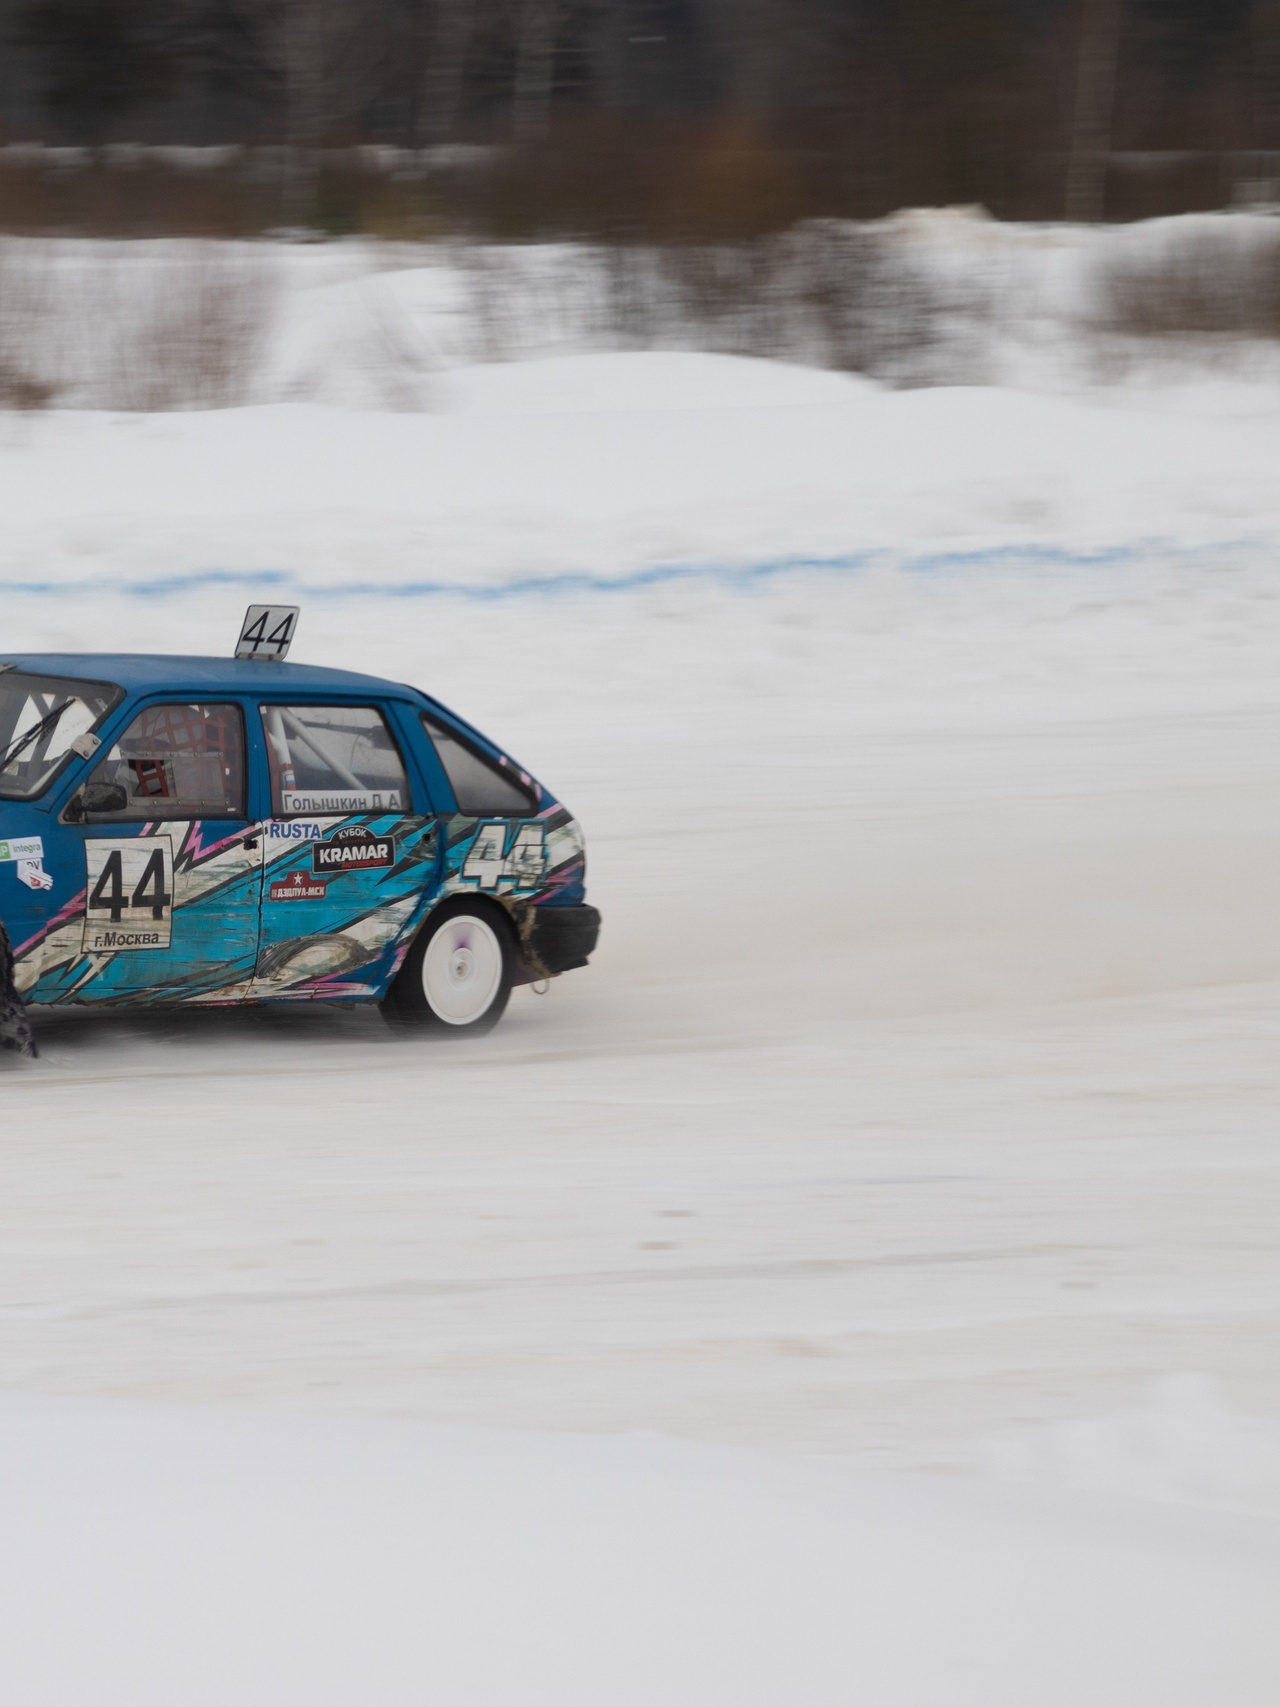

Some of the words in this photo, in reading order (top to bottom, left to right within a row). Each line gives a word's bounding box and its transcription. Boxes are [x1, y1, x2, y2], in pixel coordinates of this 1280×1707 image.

[242, 611, 294, 654] 44
[284, 794, 367, 811] Голышкин
[270, 823, 321, 838] RUSTA
[338, 827, 367, 840] КУБОК
[13, 844, 41, 854] integra
[319, 843, 389, 864] KRAMAR
[461, 822, 546, 890] 44
[340, 858, 388, 869] MOTORSPORT
[89, 848, 171, 923] 44
[94, 932, 160, 947] г.Москва
